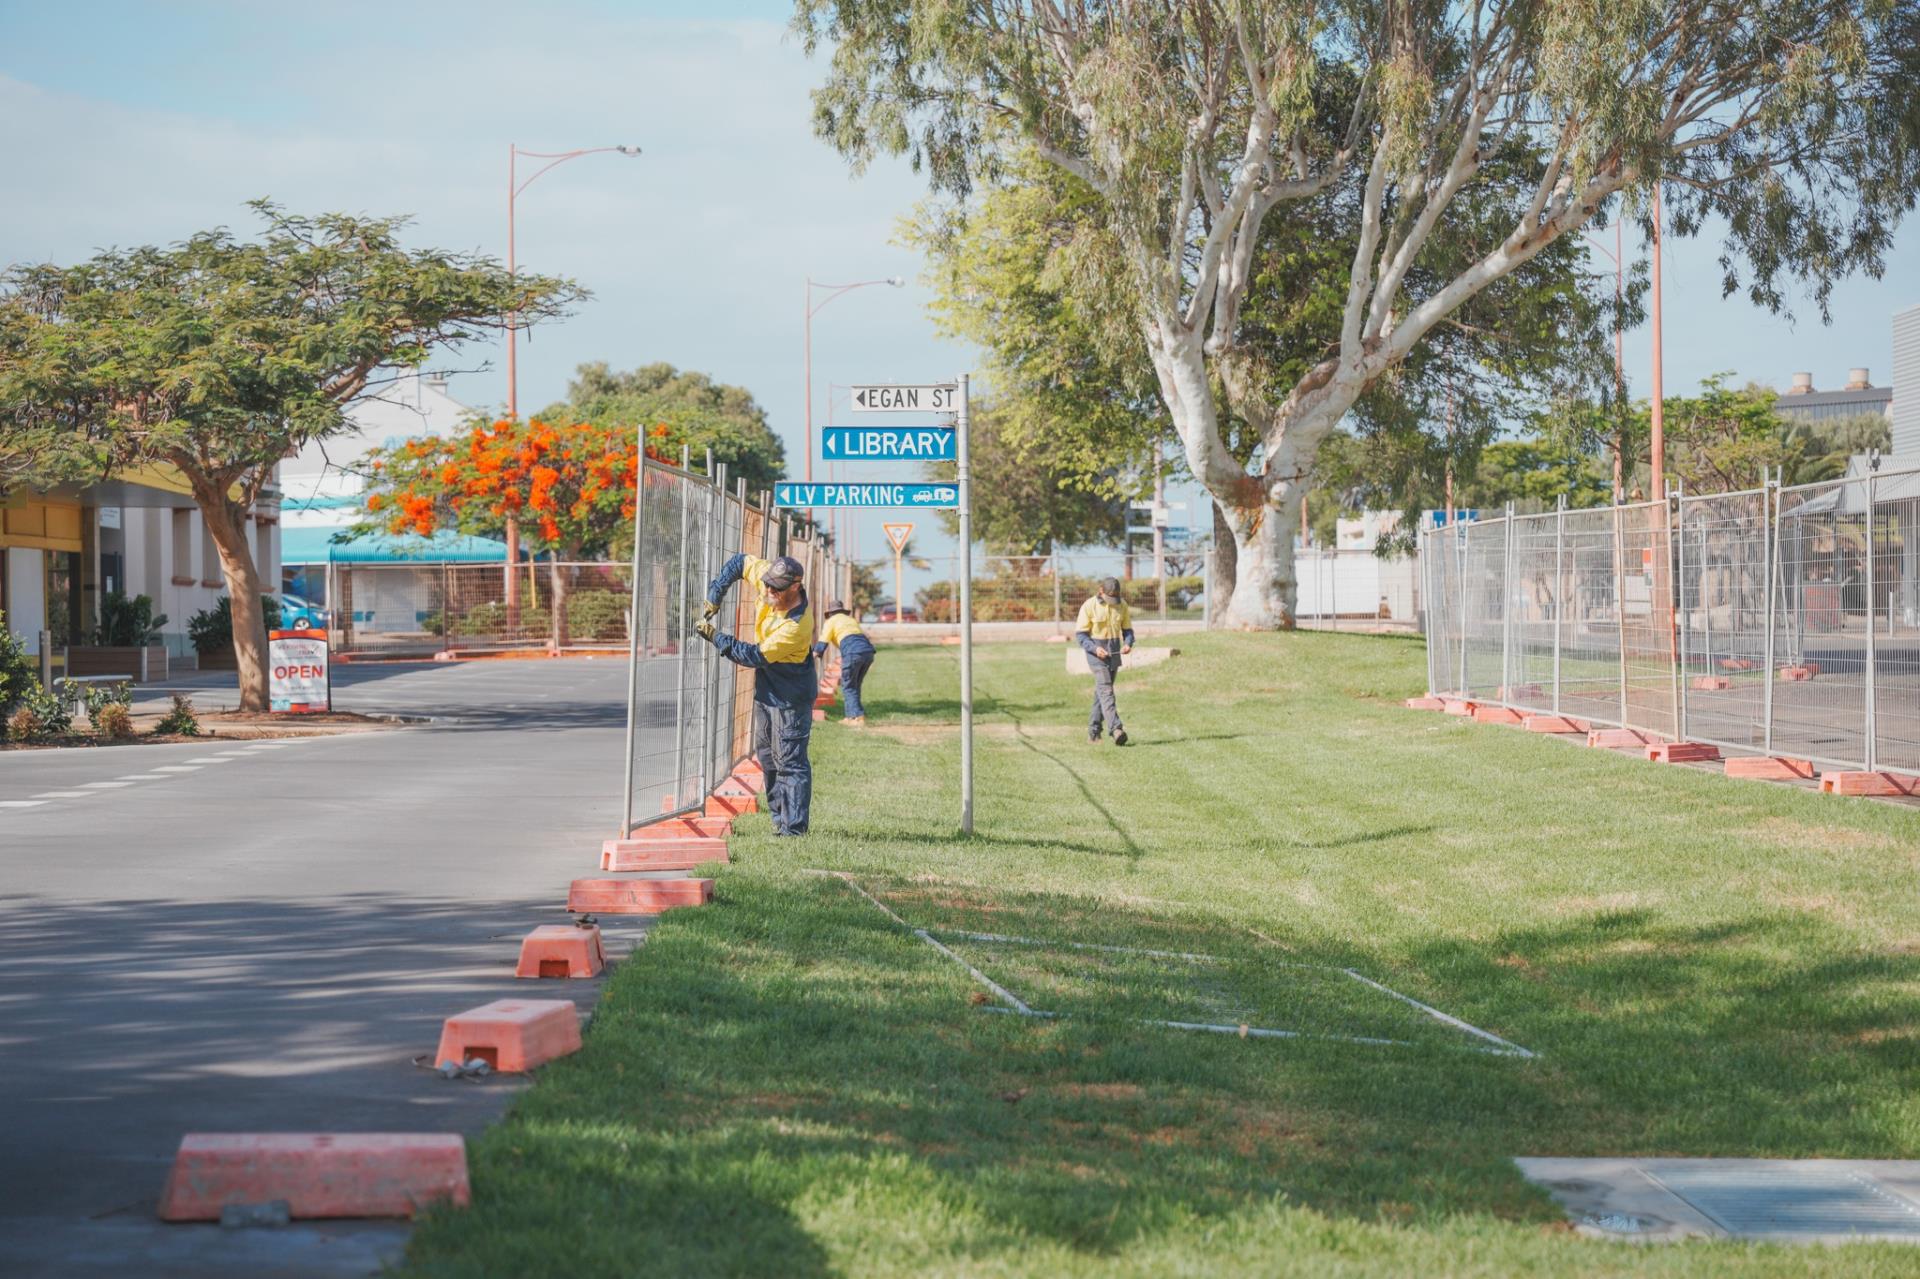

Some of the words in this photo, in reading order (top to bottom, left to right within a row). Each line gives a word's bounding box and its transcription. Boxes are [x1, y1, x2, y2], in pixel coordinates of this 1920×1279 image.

[869, 389, 918, 408] EGAN
[932, 389, 954, 408] ST
[844, 432, 951, 455] LIBRARY
[795, 486, 816, 505] LV
[824, 486, 904, 505] PARKING
[274, 665, 323, 680] OPEN
